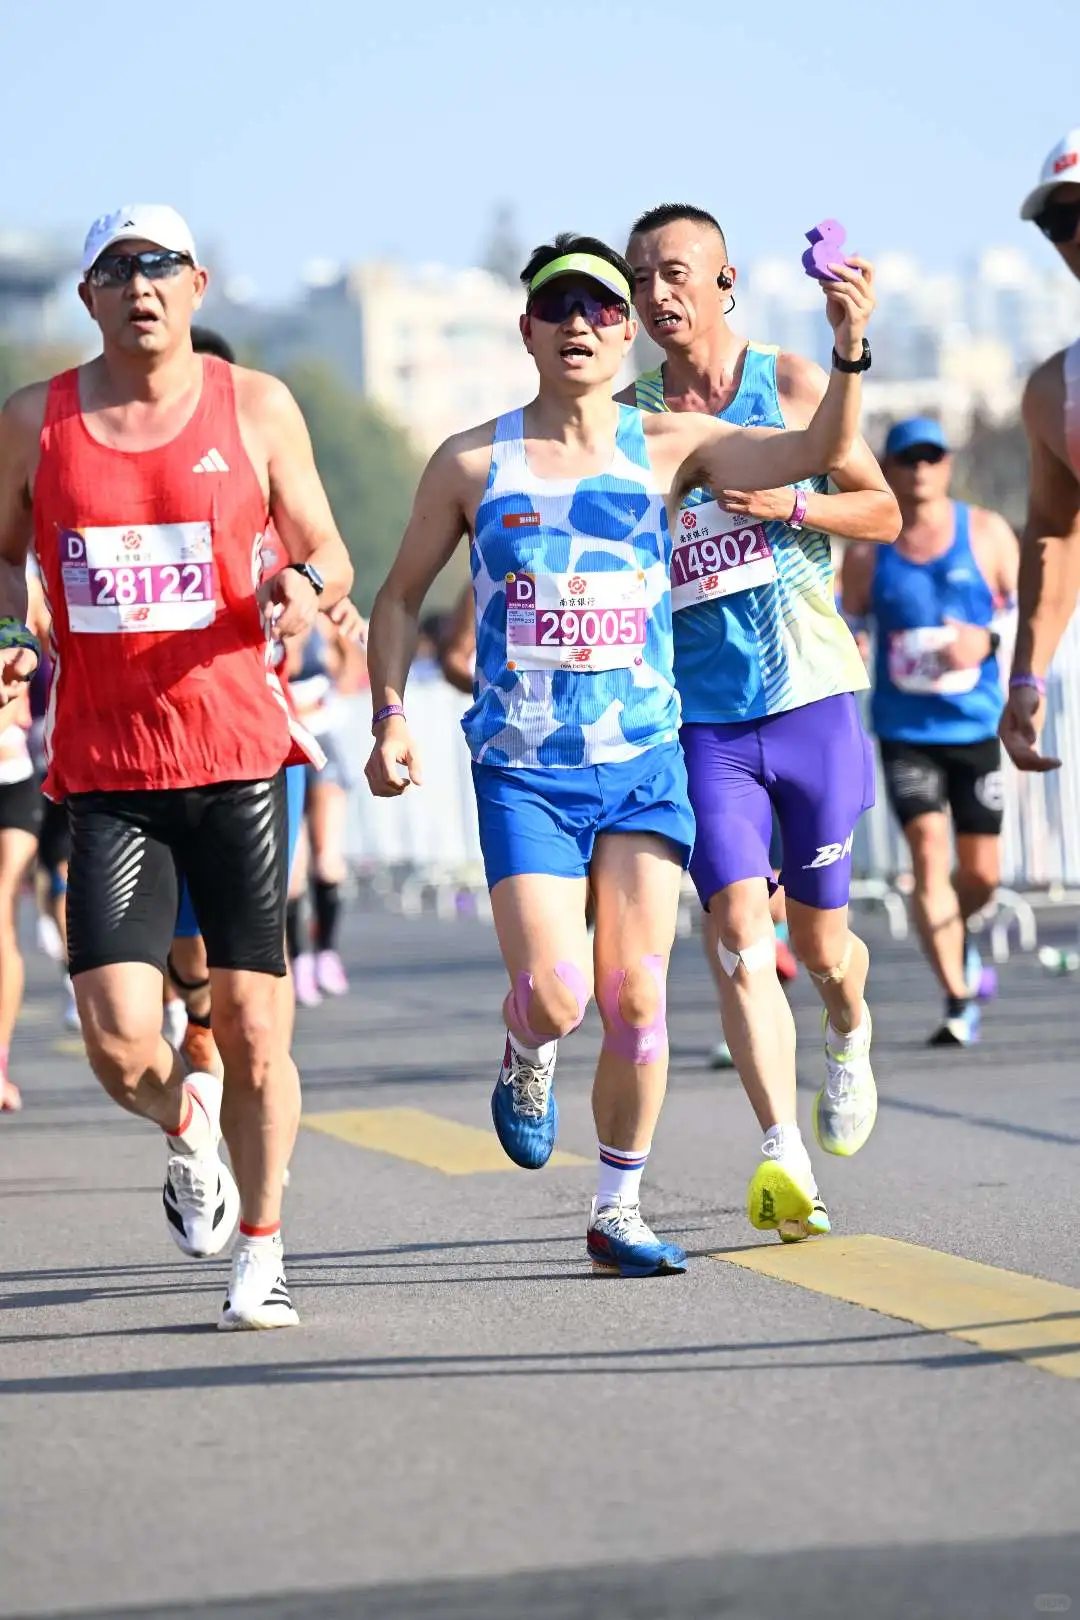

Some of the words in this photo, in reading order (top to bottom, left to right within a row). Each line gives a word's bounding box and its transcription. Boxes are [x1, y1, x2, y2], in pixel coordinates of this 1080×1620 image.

[680, 527, 709, 543] 南京银行
[68, 538, 84, 559] D
[674, 529, 762, 581] 14902
[94, 564, 204, 605] 28122
[516, 580, 533, 600] D
[559, 597, 596, 607] 南京银行
[541, 610, 637, 645] 29005
